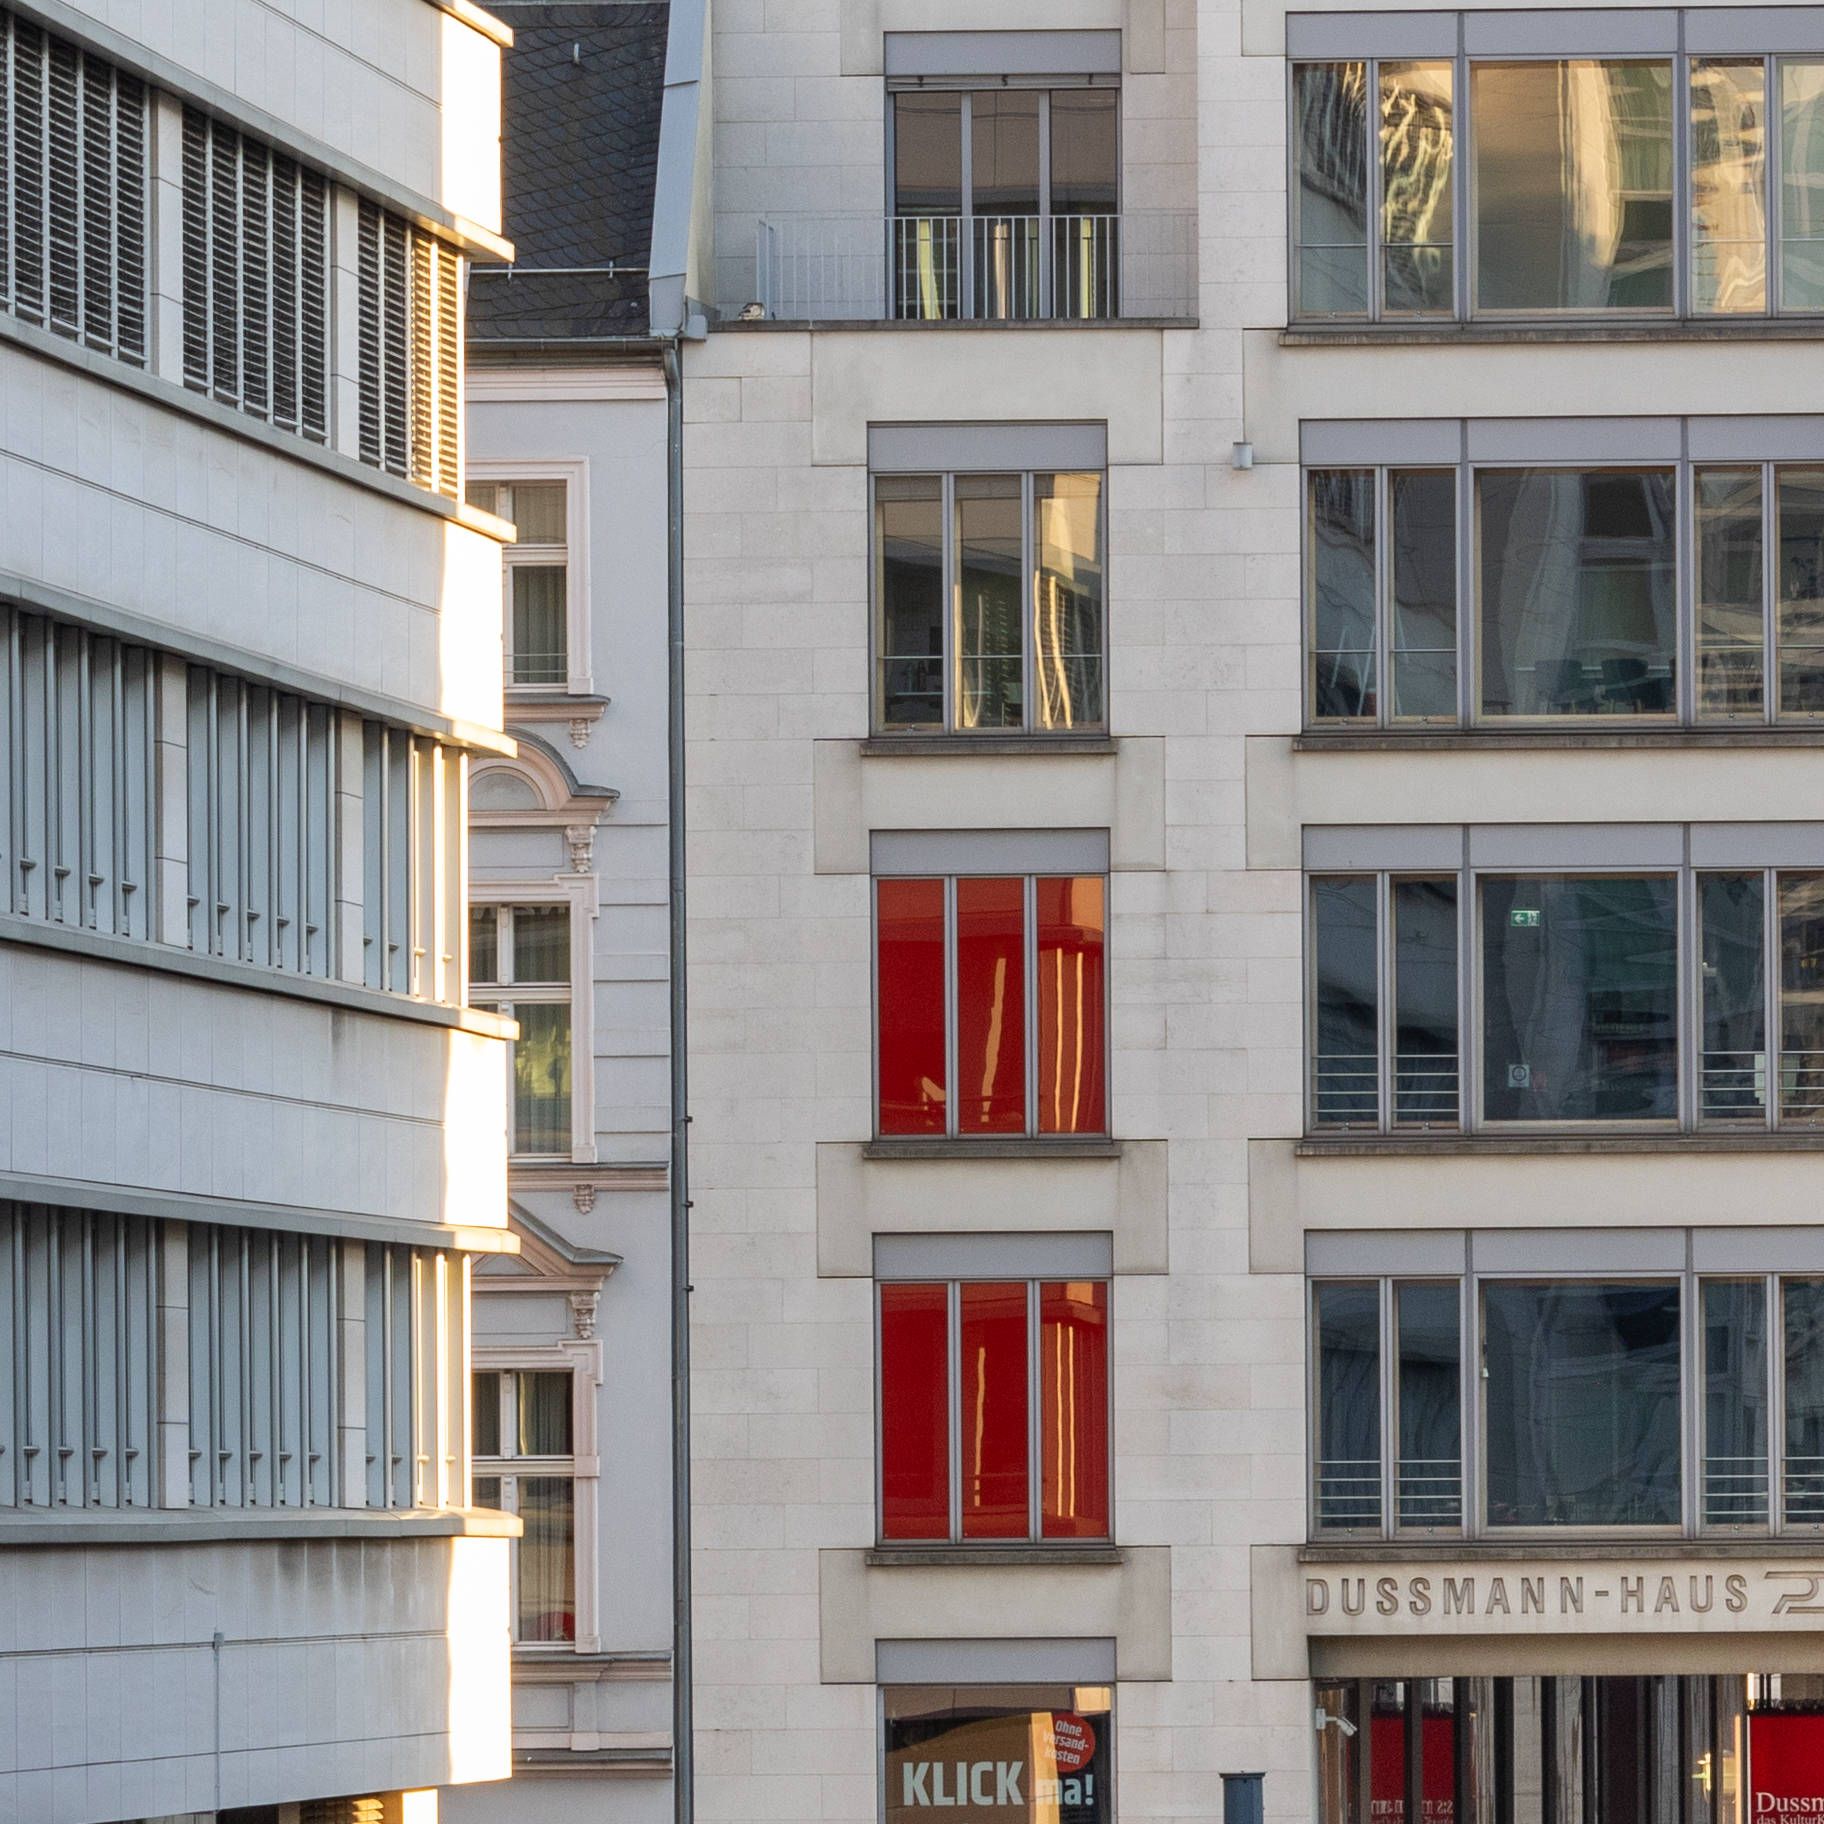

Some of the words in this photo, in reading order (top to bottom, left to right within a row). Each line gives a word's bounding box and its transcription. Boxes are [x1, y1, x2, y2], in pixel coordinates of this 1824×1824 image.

[1306, 1574, 1748, 1616] DUSSMANN-HAUS
[903, 1761, 1024, 1806] KLICK
[1035, 1773, 1094, 1806] ma!
